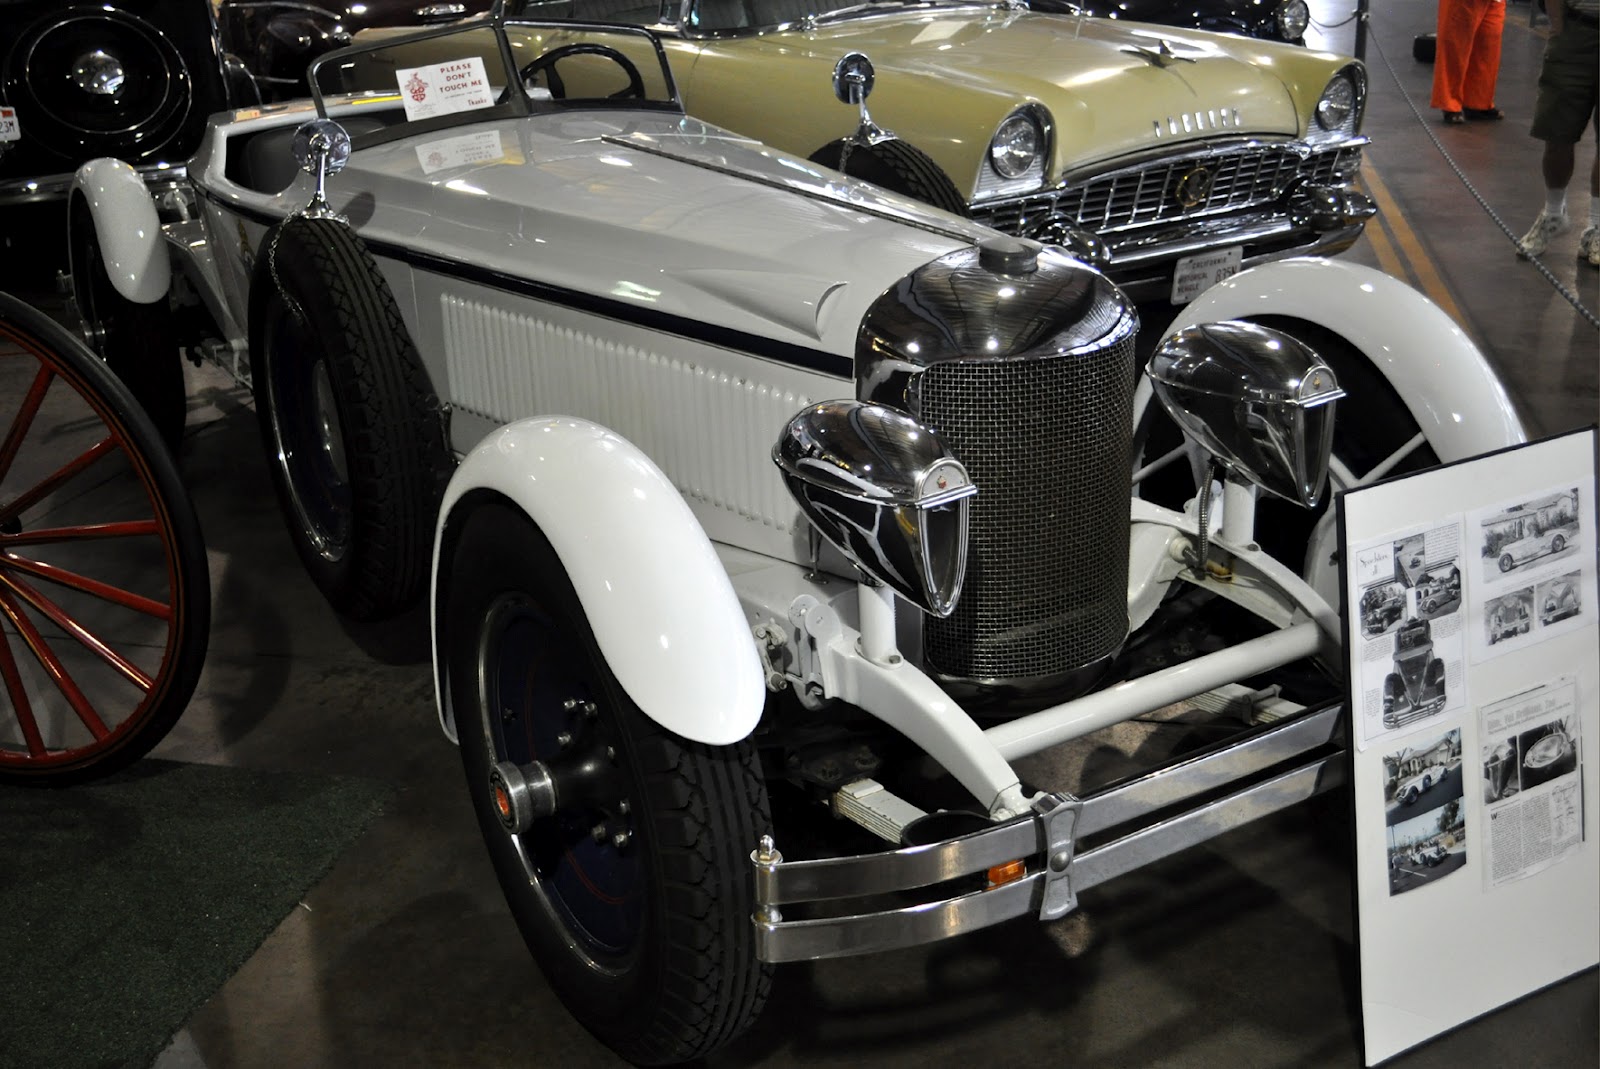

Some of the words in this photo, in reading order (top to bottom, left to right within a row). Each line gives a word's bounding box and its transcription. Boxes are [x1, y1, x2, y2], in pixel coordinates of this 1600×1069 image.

[440, 63, 472, 74] PLEASE
[446, 72, 471, 82] DON'T
[439, 83, 468, 93] TOUCH
[471, 79, 483, 87] ME
[468, 98, 487, 107] Thanks
